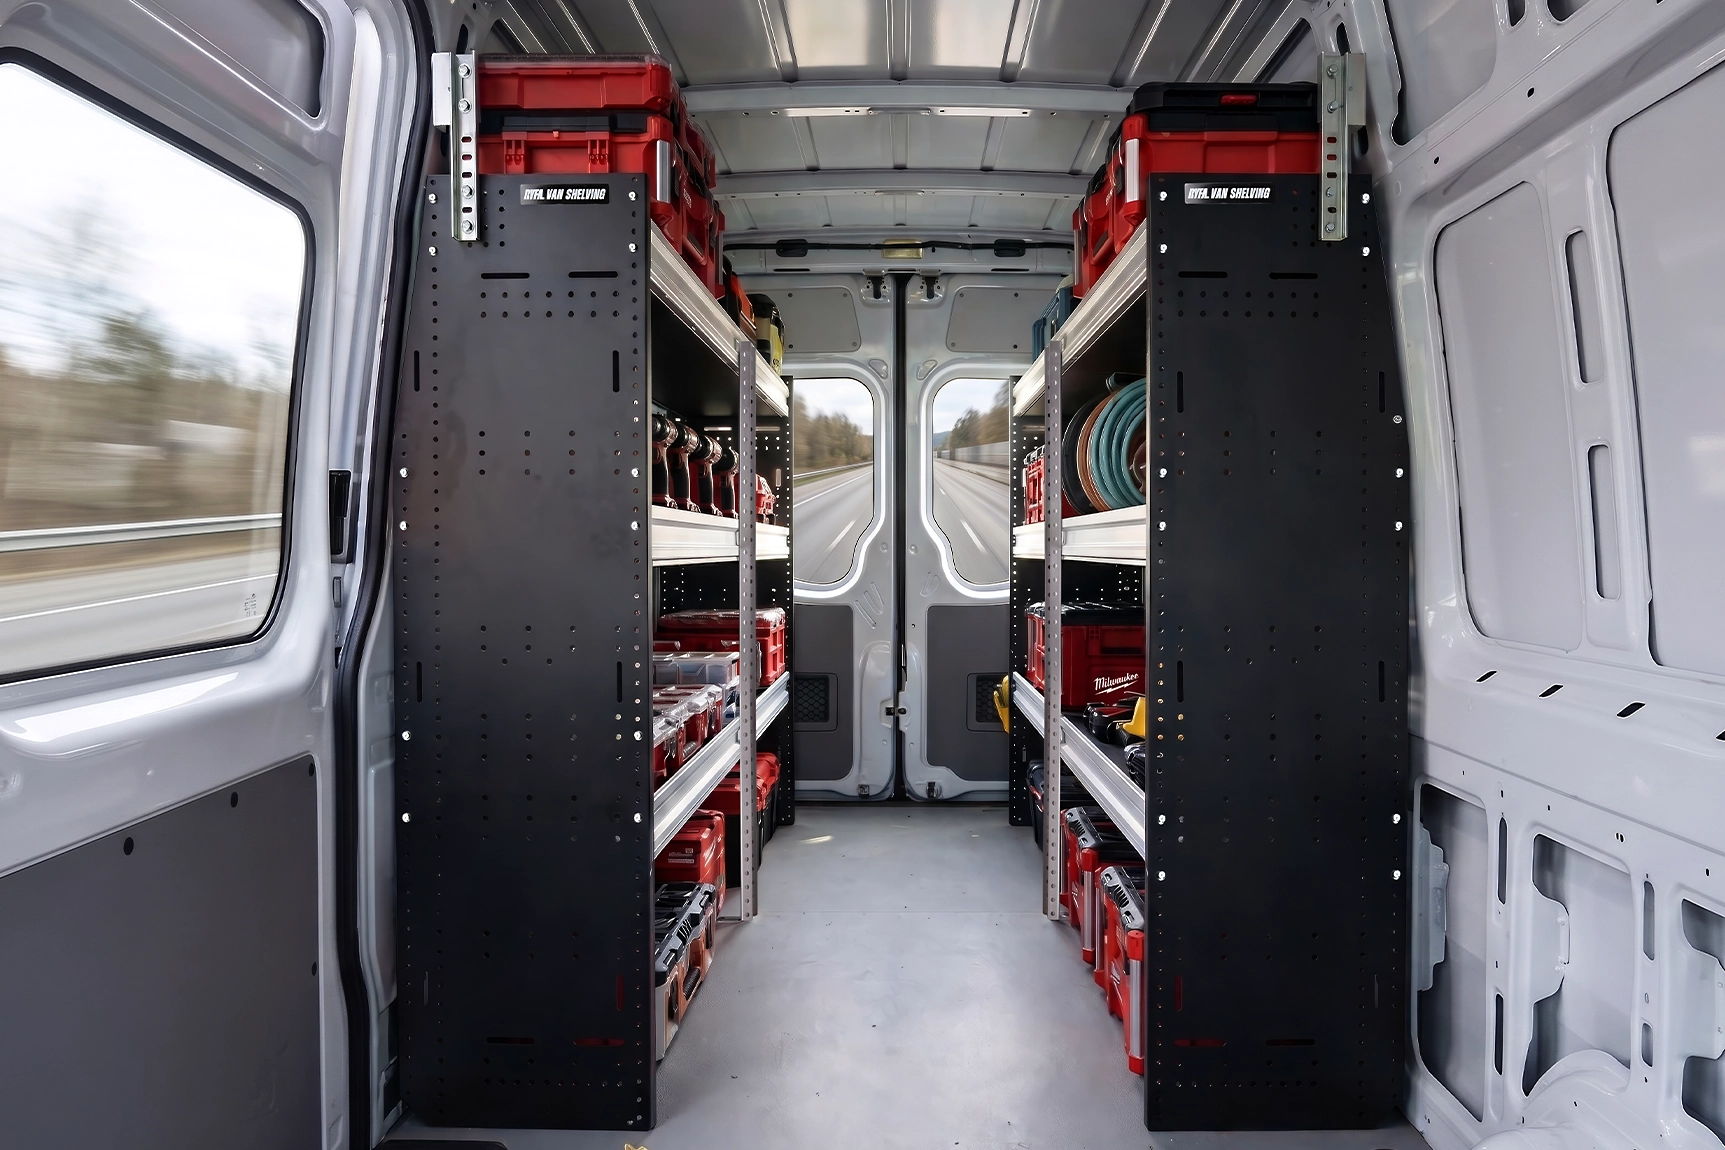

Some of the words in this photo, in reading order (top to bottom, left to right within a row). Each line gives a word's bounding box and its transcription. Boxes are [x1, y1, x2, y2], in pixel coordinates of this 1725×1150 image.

[546, 188, 565, 200] VAN
[565, 188, 606, 200] SHELVING
[1210, 187, 1229, 199] VAN
[1229, 187, 1271, 199] SHELVING
[1094, 672, 1139, 691] Milwaukee
